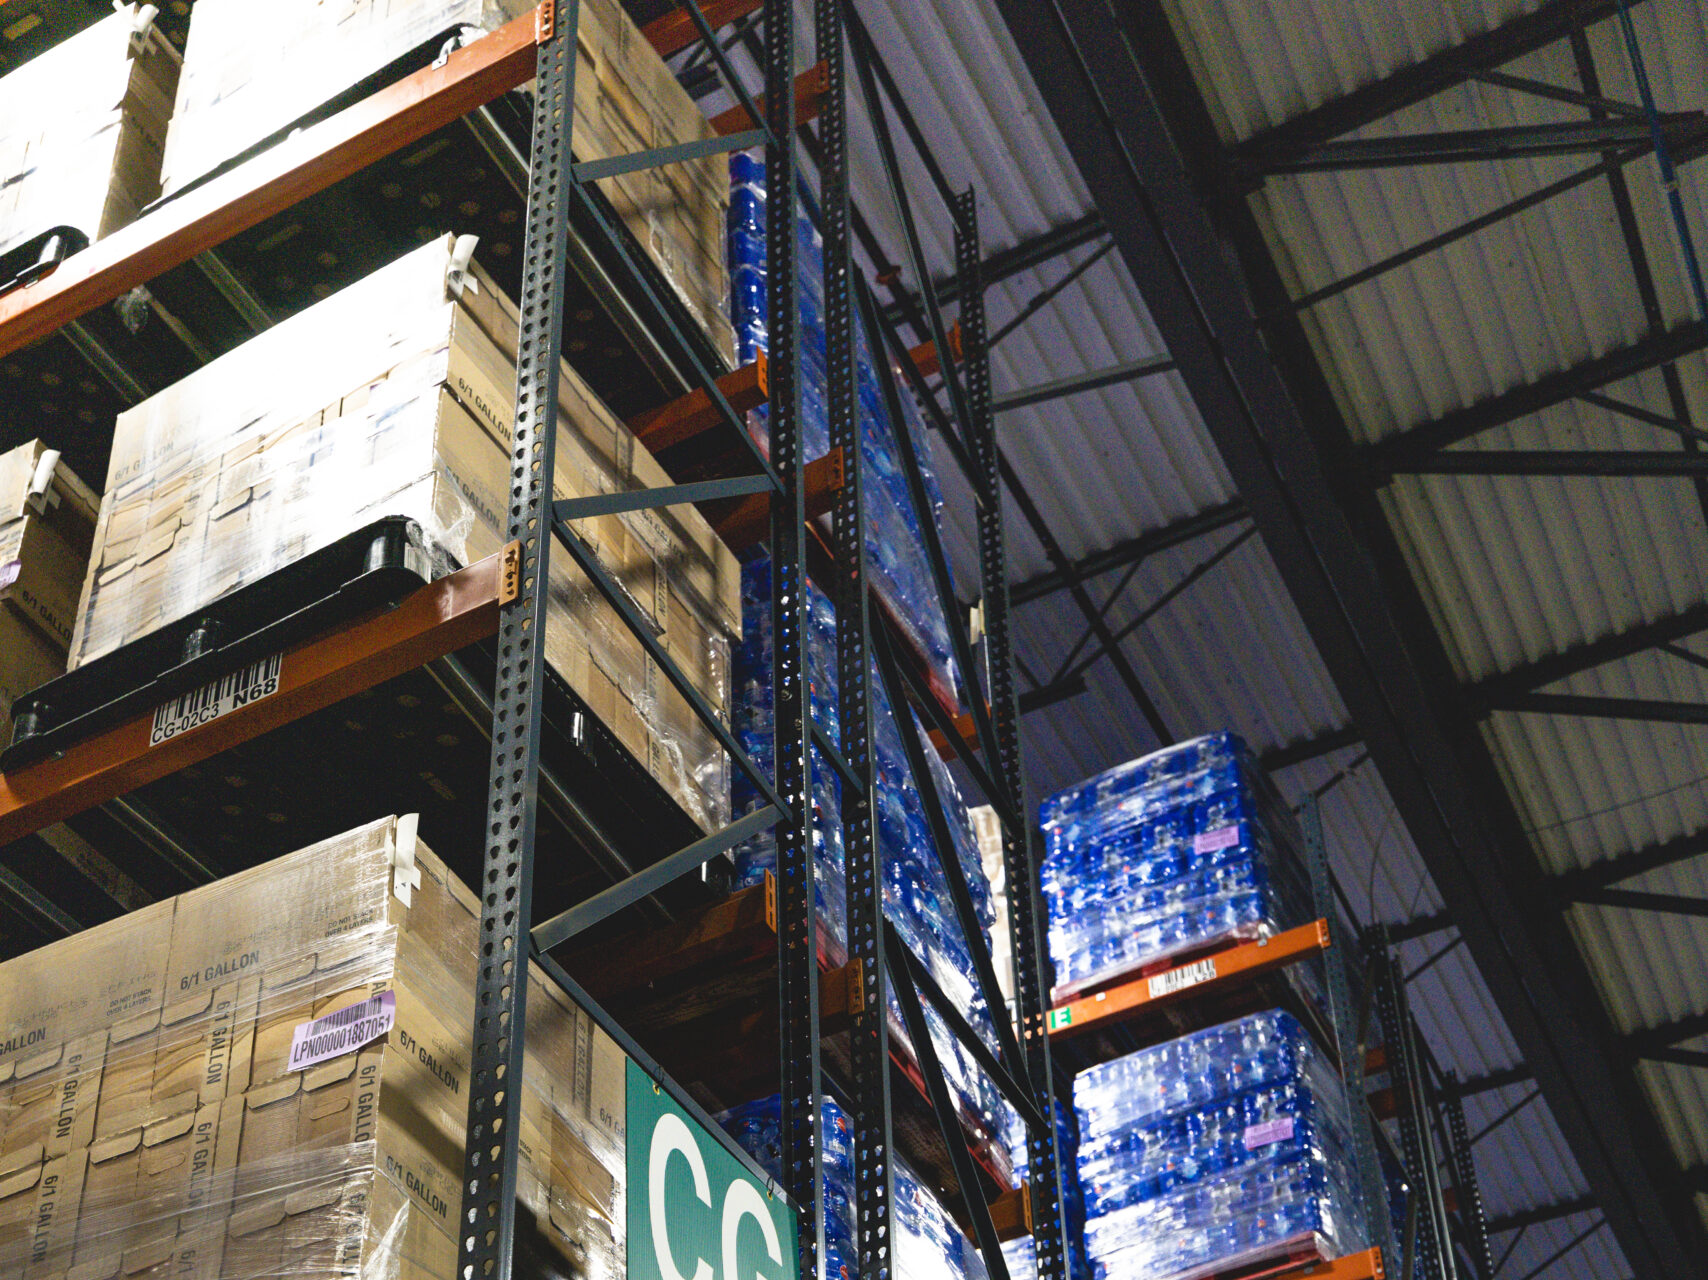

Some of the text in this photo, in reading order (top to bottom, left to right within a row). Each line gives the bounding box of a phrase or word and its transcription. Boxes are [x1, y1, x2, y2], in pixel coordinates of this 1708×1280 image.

[475, 395, 511, 442] GALLON
[152, 678, 277, 744] CG-02C3 N68
[180, 972, 199, 990] 6/1
[204, 950, 260, 982] GALLON
[206, 1000, 230, 1086] 6/1 GALLON
[293, 1013, 391, 1063] LPN000001887051
[1056, 1008, 1070, 1028] E
[400, 1030, 416, 1054] 6/1
[418, 1047, 459, 1094] GALLON
[56, 1054, 82, 1138] 6/1 GALLON
[354, 1065, 376, 1143] 6/1 GALLO
[196, 1122, 212, 1145] 6/1
[32, 1175, 58, 1263] 6/1 GALLON
[386, 1155, 402, 1179] 6/1
[406, 1171, 447, 1219] GALLON
[179, 1250, 196, 1273] 6/1
